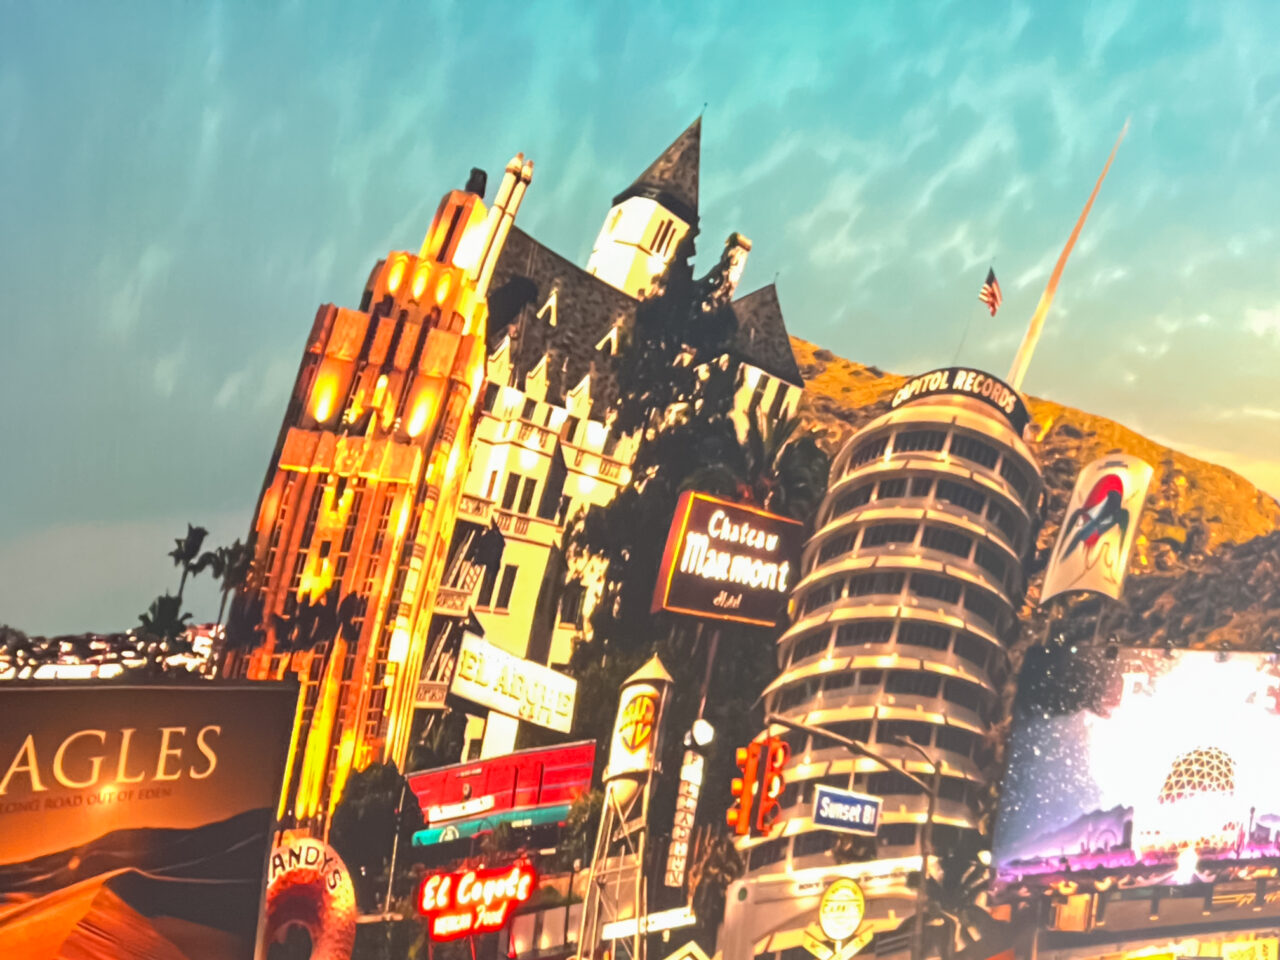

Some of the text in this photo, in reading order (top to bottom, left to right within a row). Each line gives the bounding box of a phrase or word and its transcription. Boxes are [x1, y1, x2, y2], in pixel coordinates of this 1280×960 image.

[891, 369, 1017, 414] CAPITOL RECORDS
[708, 509, 778, 551] Chateau
[680, 530, 790, 593] Marmont
[0, 725, 222, 795] AGLES
[44, 795, 83, 810] ROAD
[819, 796, 861, 822] Sunset
[270, 846, 342, 891] ANDYS
[422, 868, 530, 911] El Coyote
